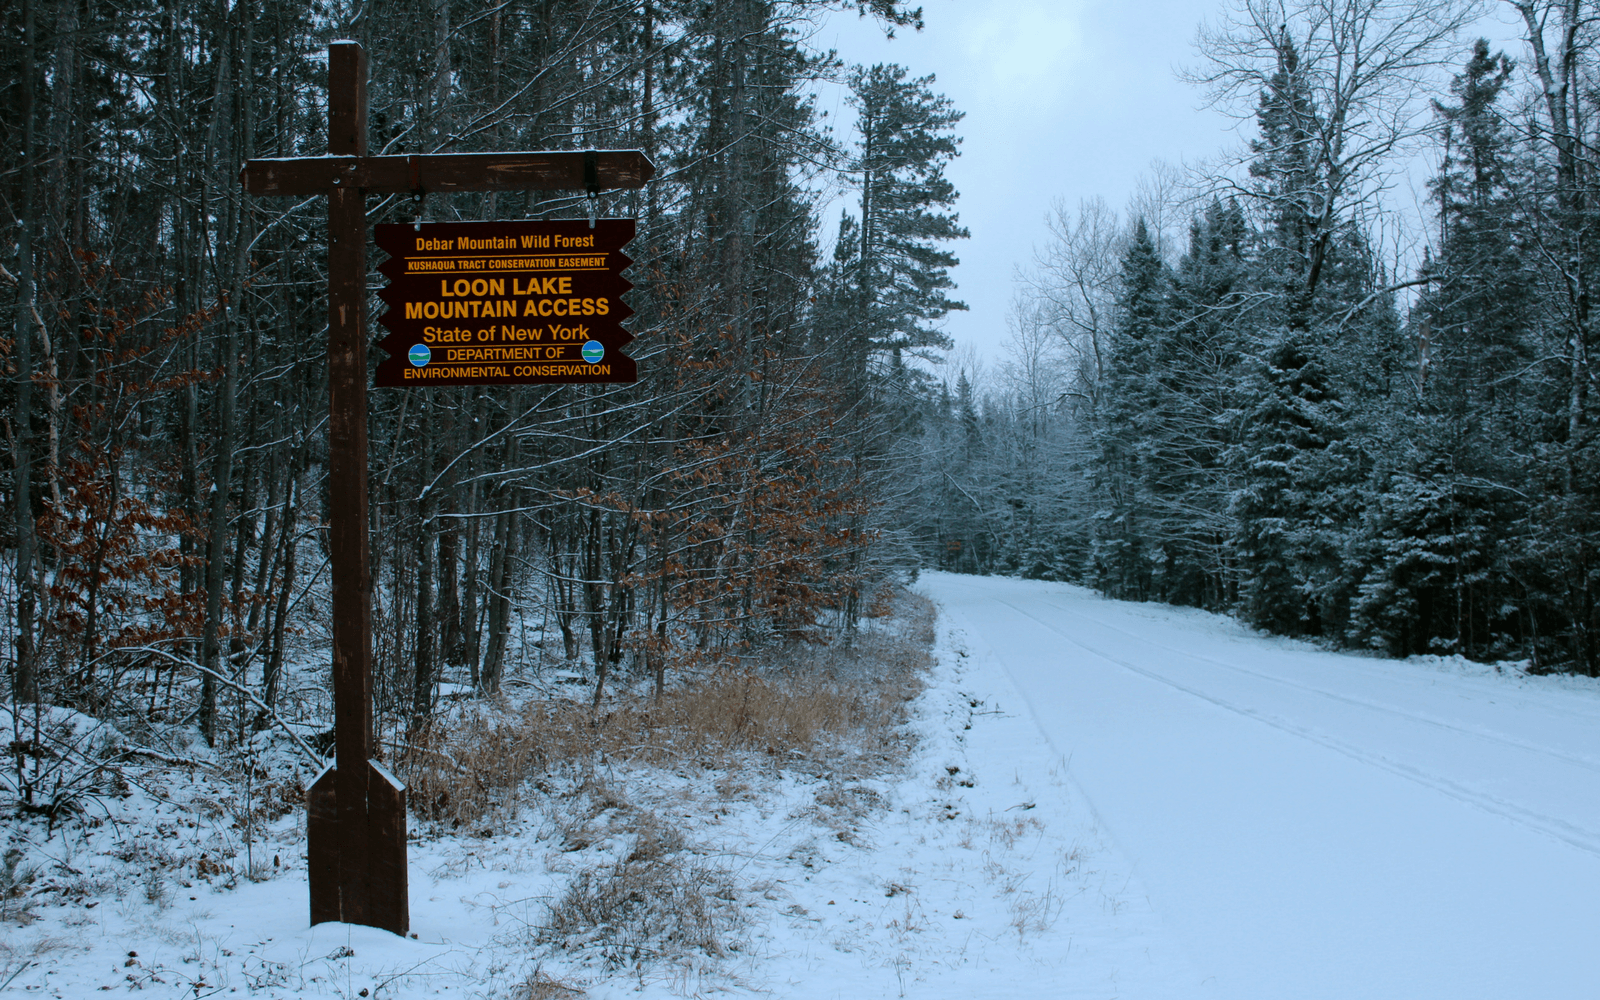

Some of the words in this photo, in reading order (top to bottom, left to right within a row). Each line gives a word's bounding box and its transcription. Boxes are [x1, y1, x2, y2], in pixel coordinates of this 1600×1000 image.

[416, 238, 453, 251] Debar
[458, 236, 516, 250] Mountain
[521, 235, 549, 248] Wild
[554, 234, 594, 247] Forest
[408, 261, 455, 271] KUSHAQUA
[458, 260, 486, 270] TRACT
[489, 258, 555, 269] CONSERVATION
[559, 257, 605, 268] EASEMENT
[441, 279, 504, 297] LOON
[513, 277, 572, 295] LAKE
[405, 300, 516, 319] MOUNTAIN
[524, 298, 609, 317] ACCESS
[423, 327, 472, 343] State
[478, 326, 496, 341] of
[502, 326, 542, 341] New
[548, 324, 590, 340] York
[447, 348, 541, 361] DEPARTMENT
[546, 347, 565, 359] OF
[404, 366, 510, 379] ENVIRONMENTAL
[514, 365, 610, 376] CONSERVATION
